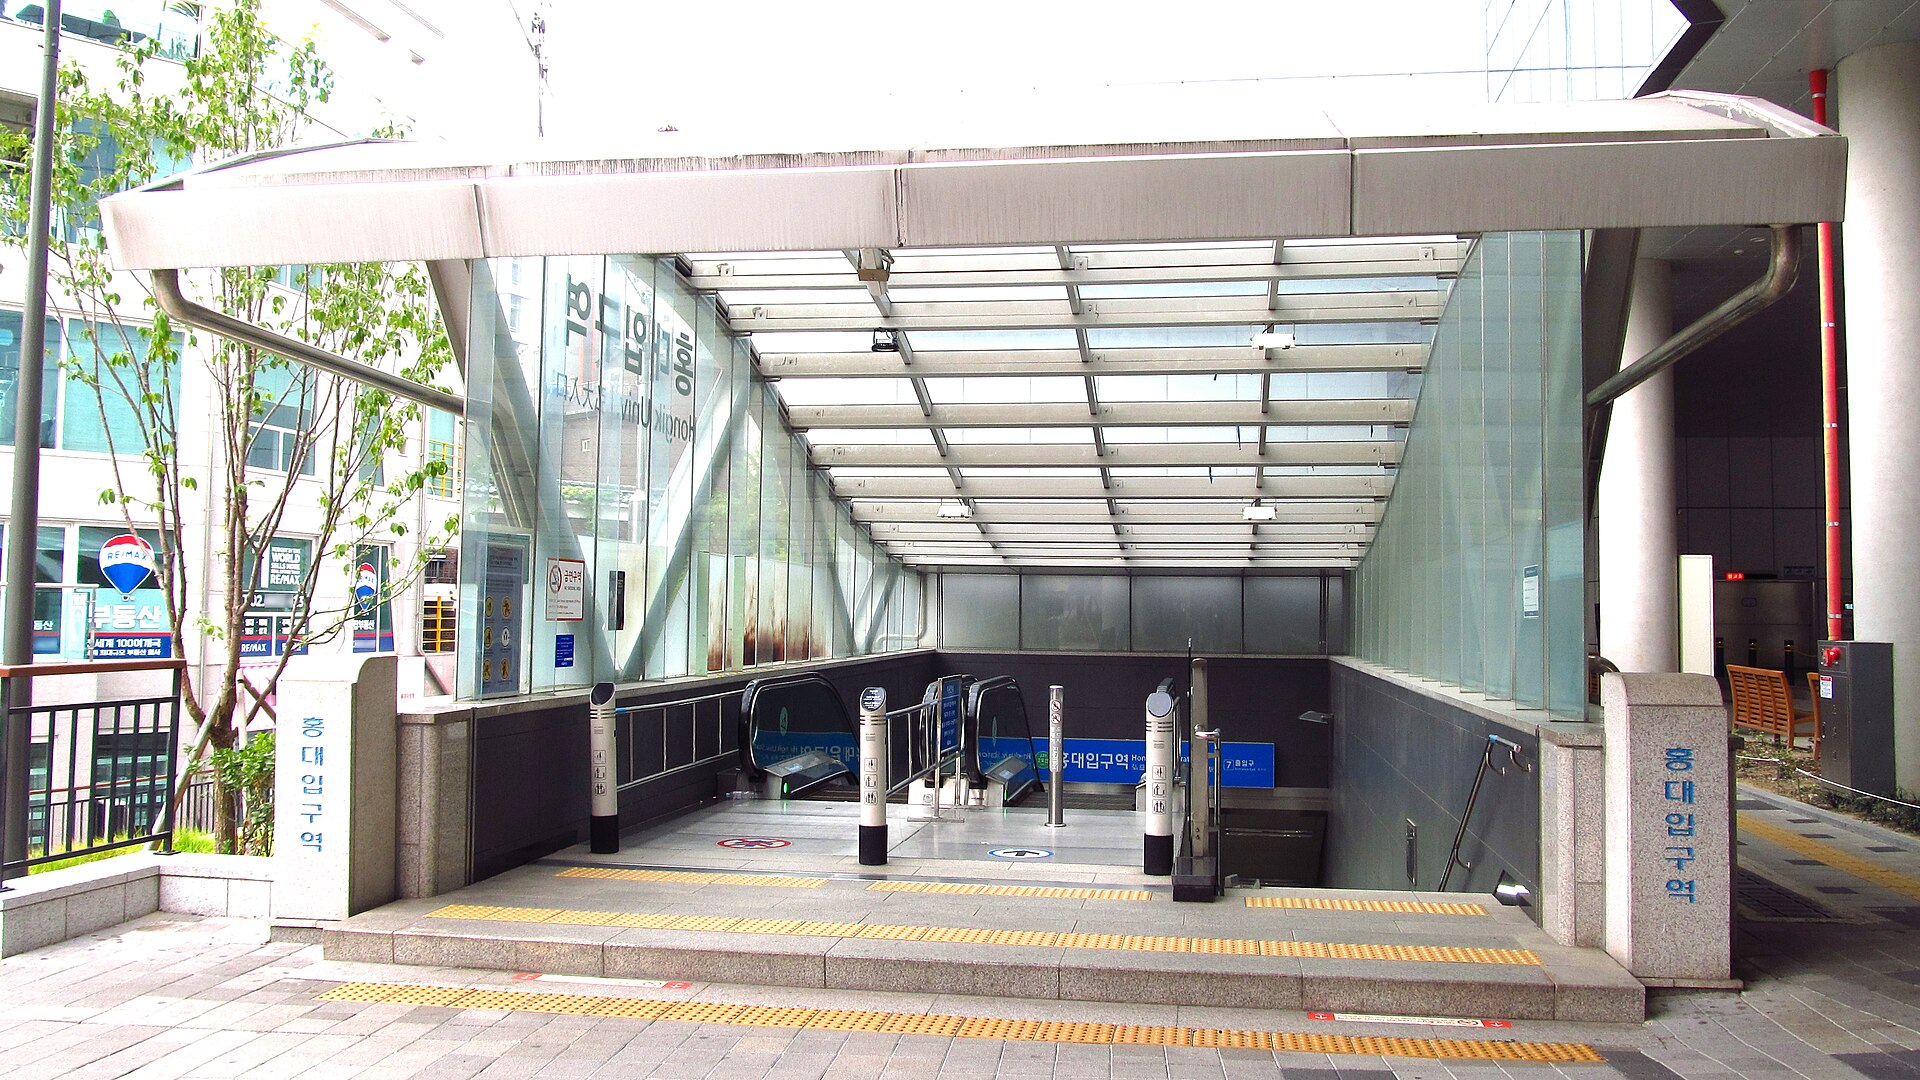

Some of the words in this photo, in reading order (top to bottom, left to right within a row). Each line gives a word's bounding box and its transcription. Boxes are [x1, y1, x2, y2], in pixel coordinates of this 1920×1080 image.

[107, 550, 147, 561] RE/MAX
[272, 552, 301, 563] WORLD
[270, 574, 301, 585] RE/MAX
[564, 570, 582, 584] 금연구역
[88, 604, 162, 630] 부동산
[33, 620, 54, 631] 동산
[241, 643, 267, 652] RE/MAX
[1235, 759, 1254, 768] 출입구
[301, 717, 324, 853] 홍대입구역
[1664, 748, 1695, 904] 홍대입구역
